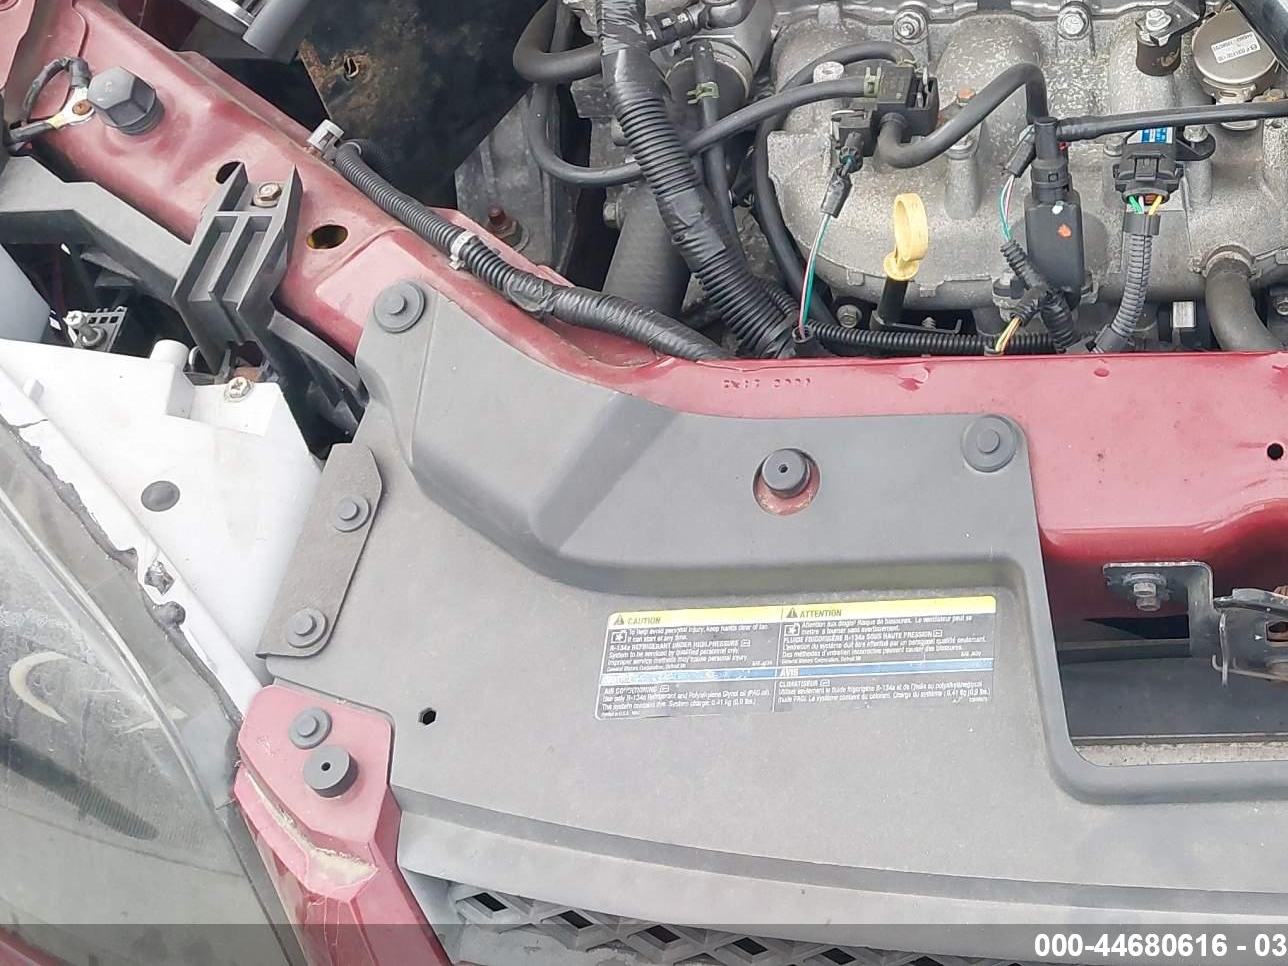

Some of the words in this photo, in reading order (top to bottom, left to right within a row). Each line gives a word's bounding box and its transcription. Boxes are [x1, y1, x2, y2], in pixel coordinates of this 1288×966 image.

[800, 609, 842, 618] ATTENTION
[608, 651, 629, 659] System
[780, 667, 799, 677] AVIS
